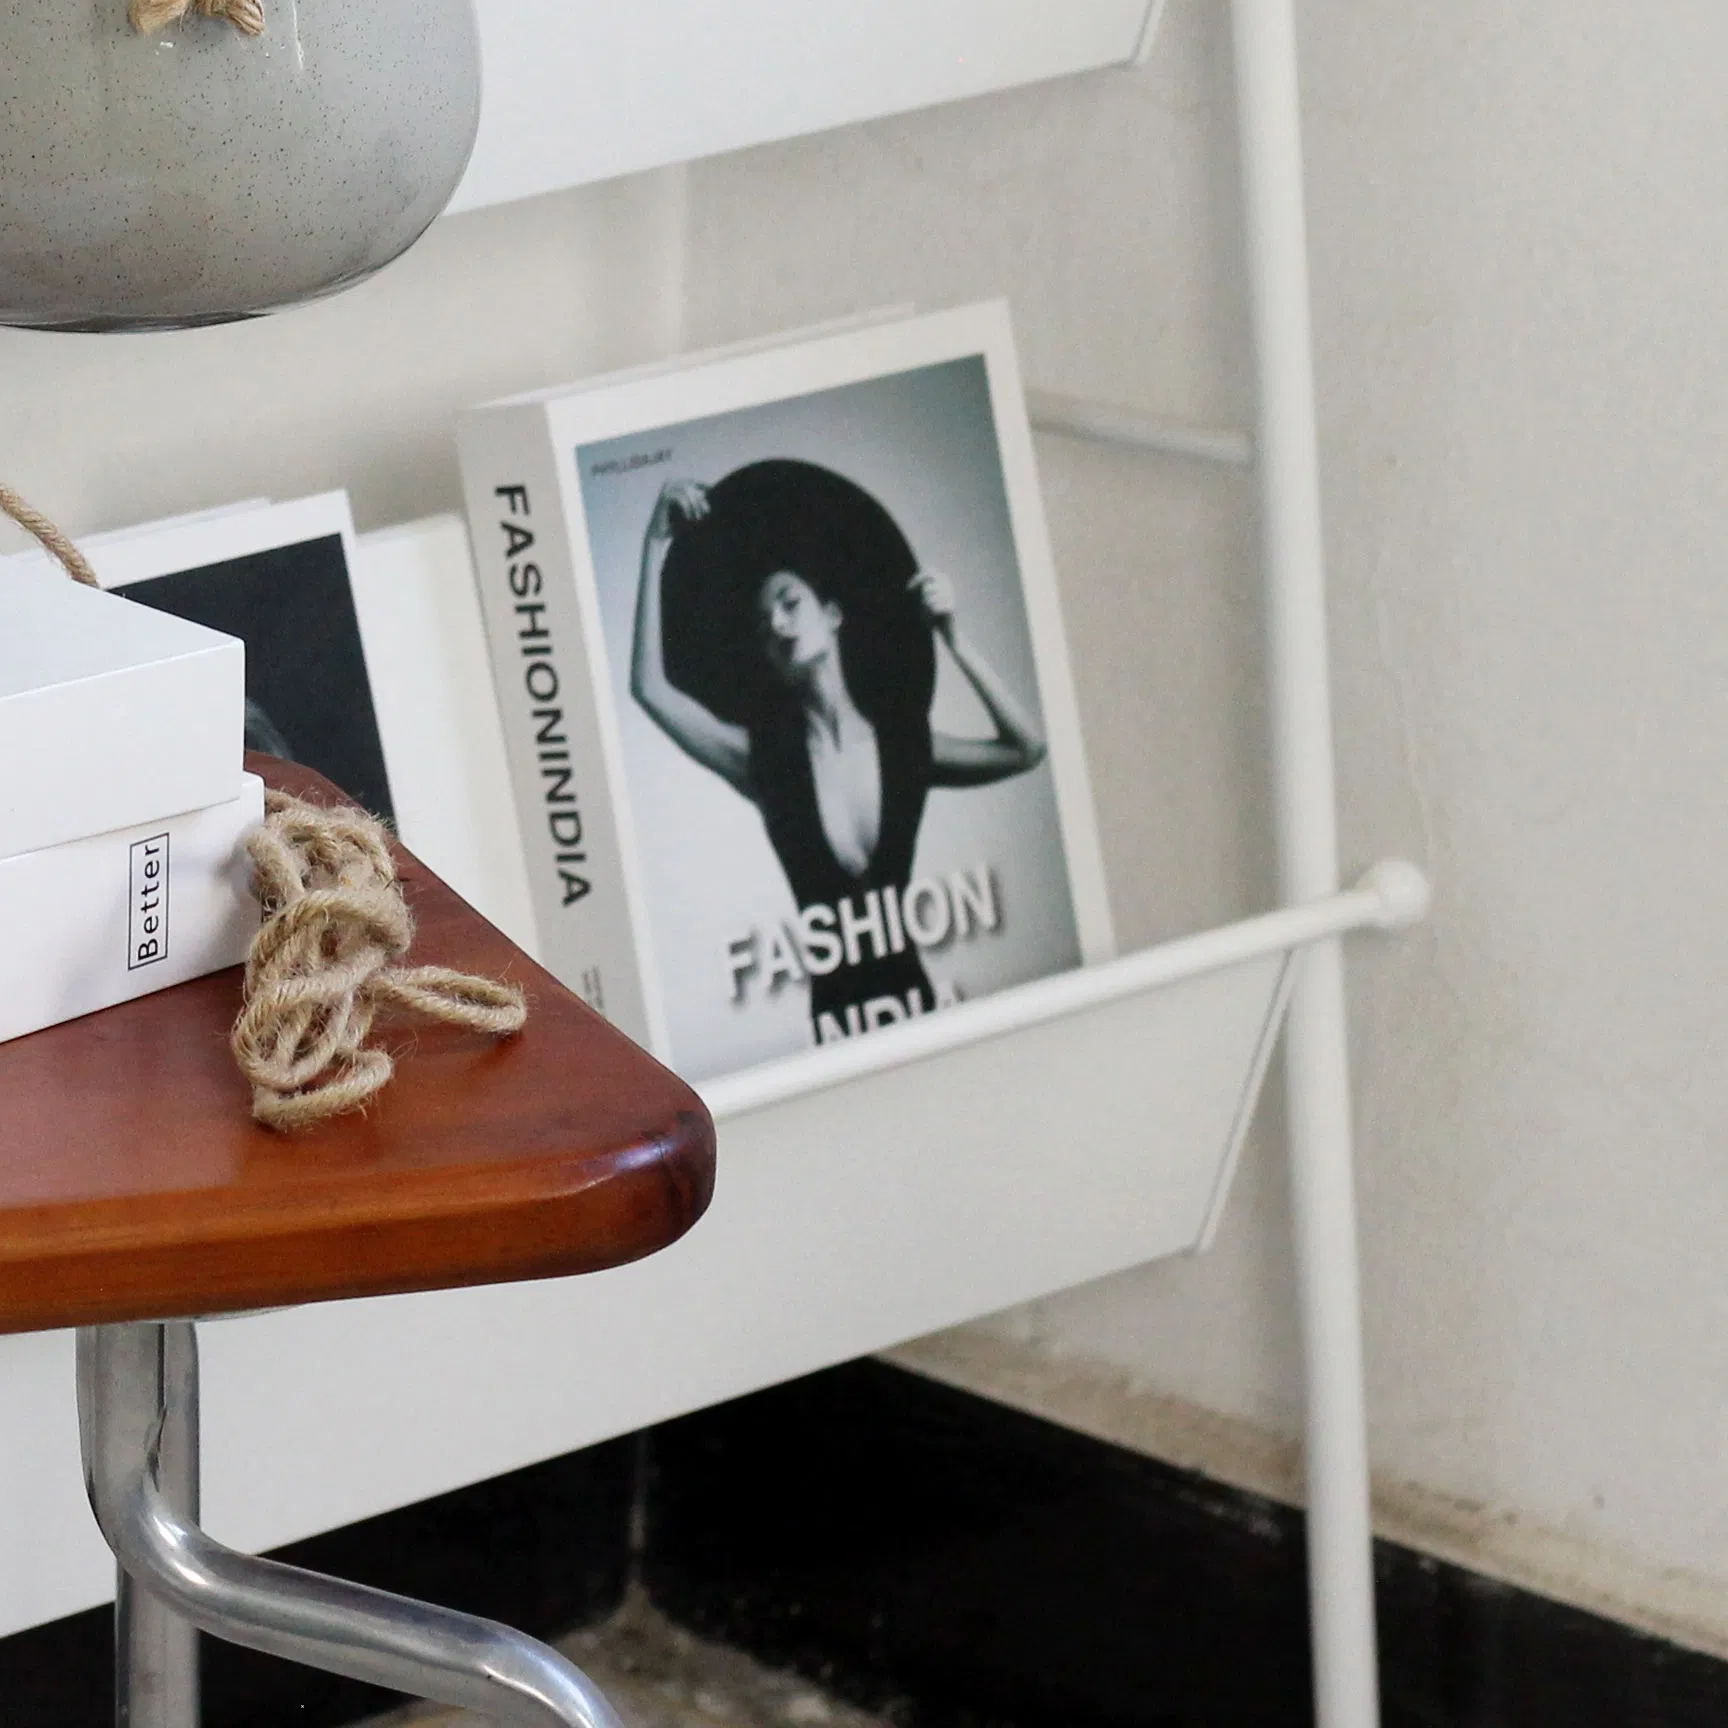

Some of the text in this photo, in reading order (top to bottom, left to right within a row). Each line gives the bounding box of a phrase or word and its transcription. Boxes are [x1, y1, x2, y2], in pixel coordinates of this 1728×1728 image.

[493, 483, 592, 908] FASHIONINDIA
[138, 844, 160, 960] Better
[722, 862, 996, 1005] FASHION
